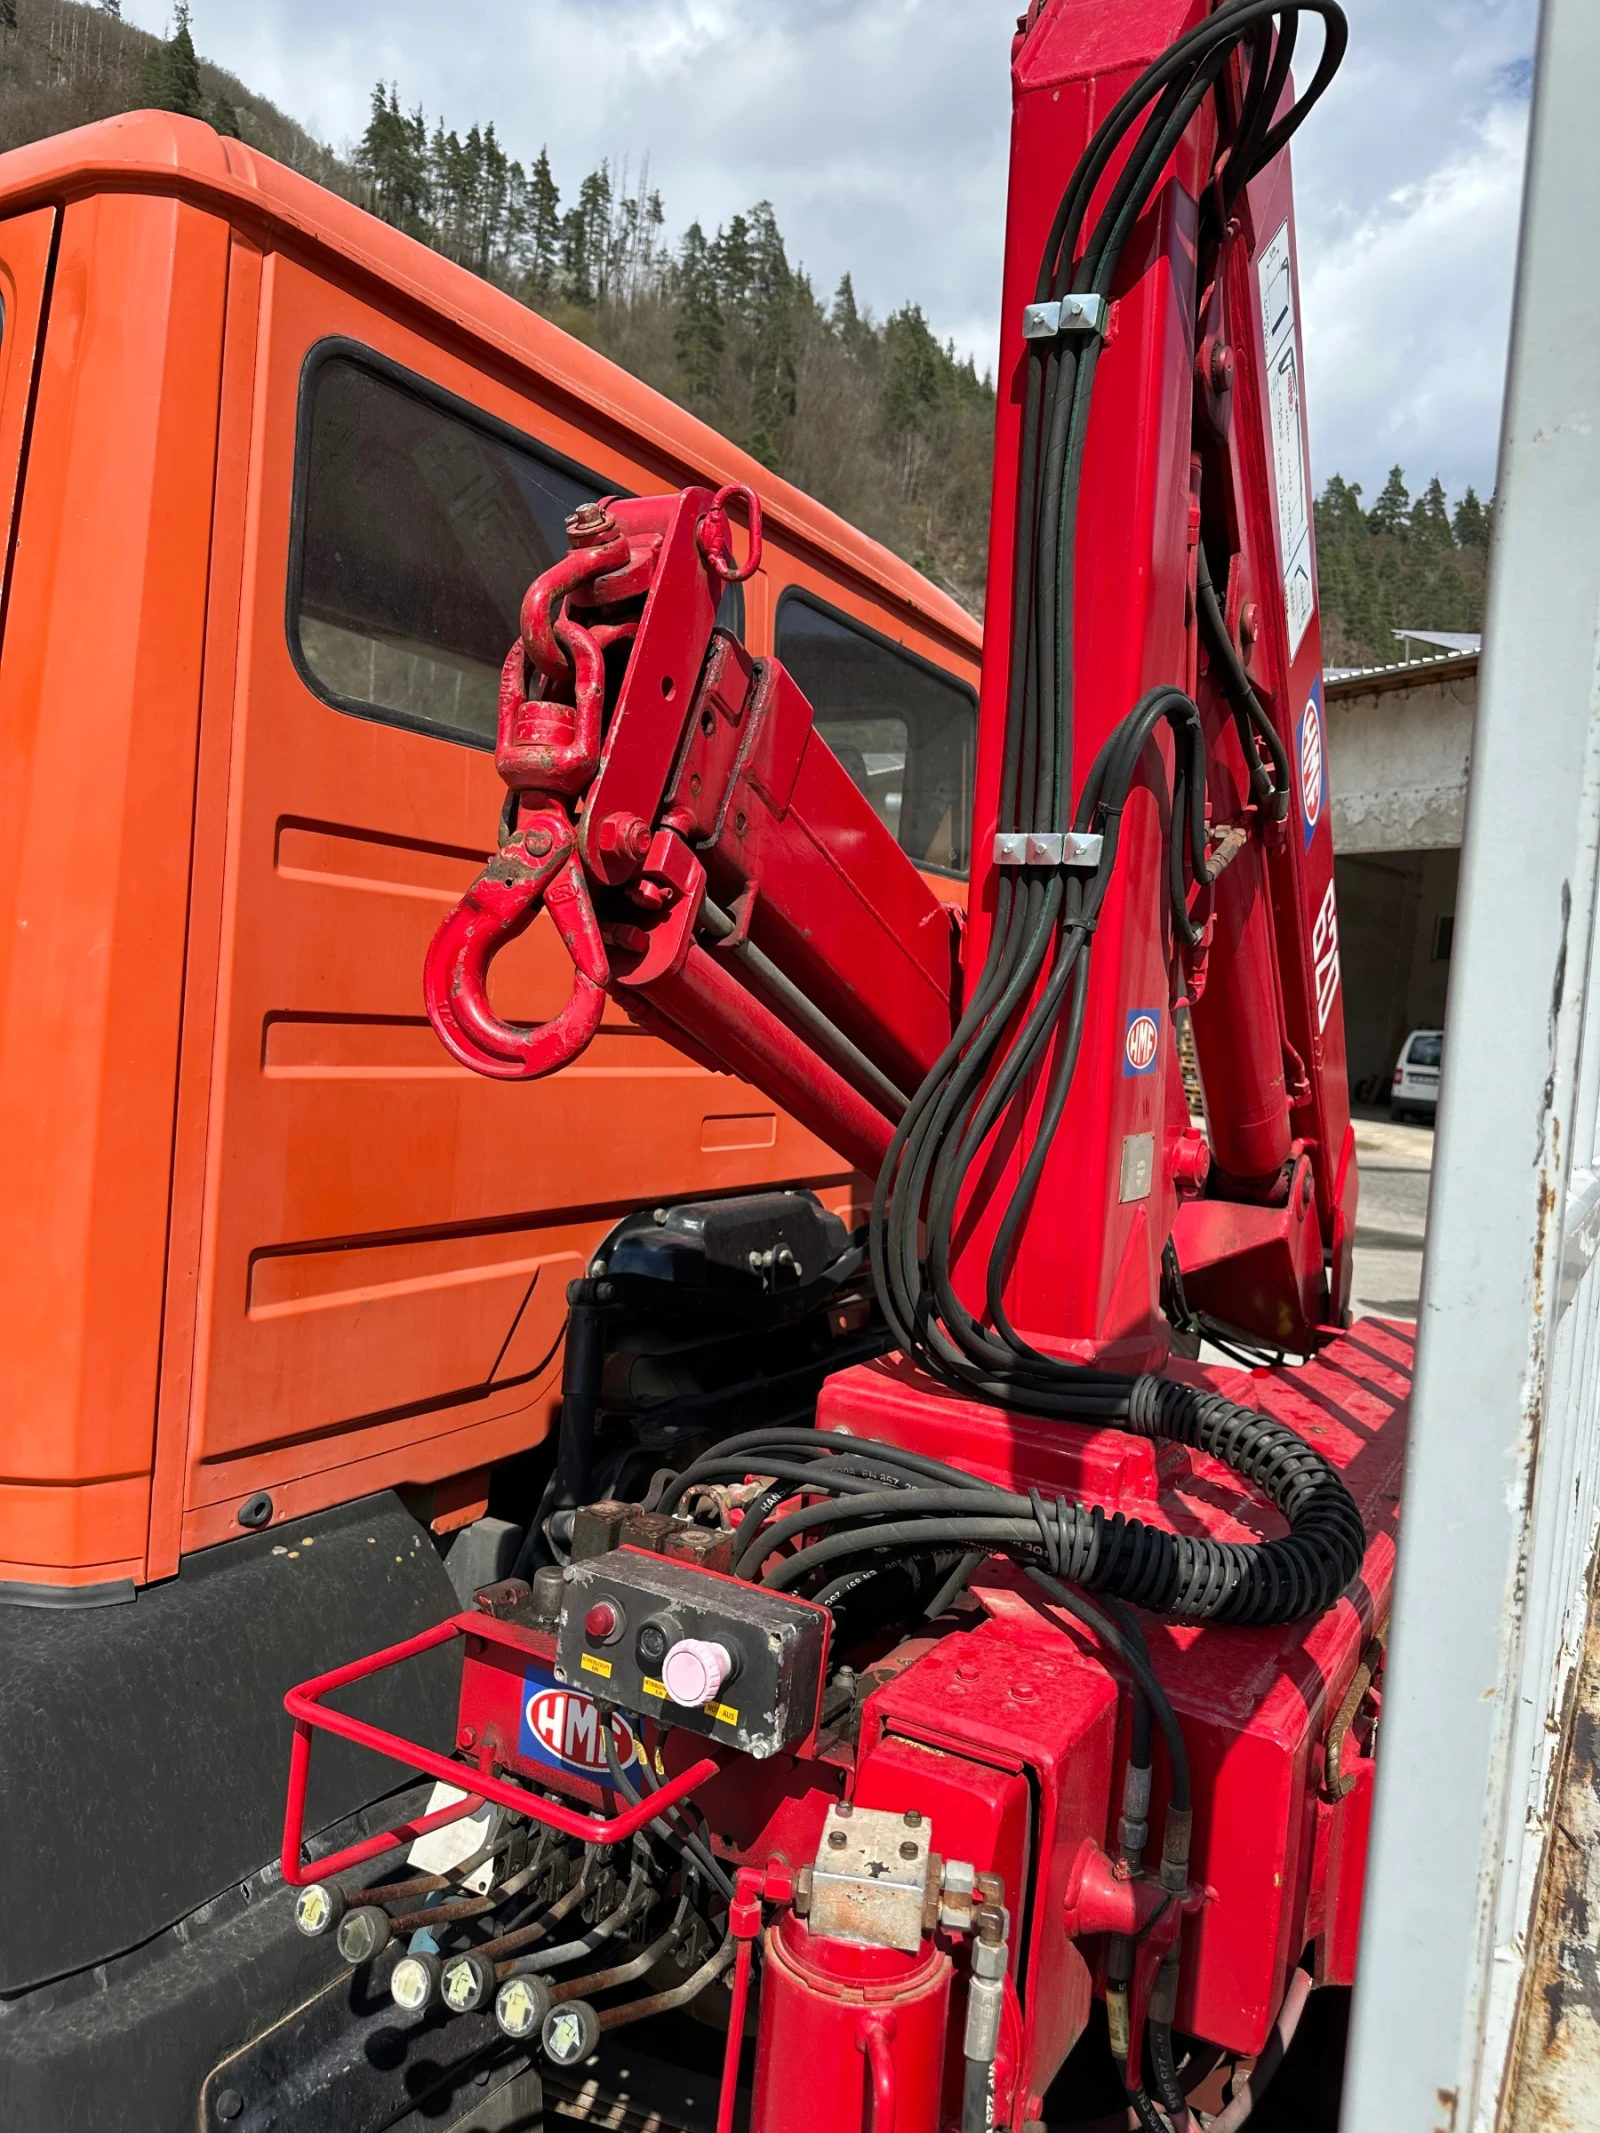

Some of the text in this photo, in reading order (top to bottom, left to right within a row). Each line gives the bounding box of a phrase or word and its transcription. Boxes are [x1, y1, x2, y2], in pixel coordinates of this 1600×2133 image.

[1303, 710, 1320, 808] HMF
[1312, 877, 1340, 1035] 620
[1129, 1021, 1155, 1065] HMF
[722, 1710, 735, 1721] AUS
[1163, 2083, 1180, 2108] BAR
